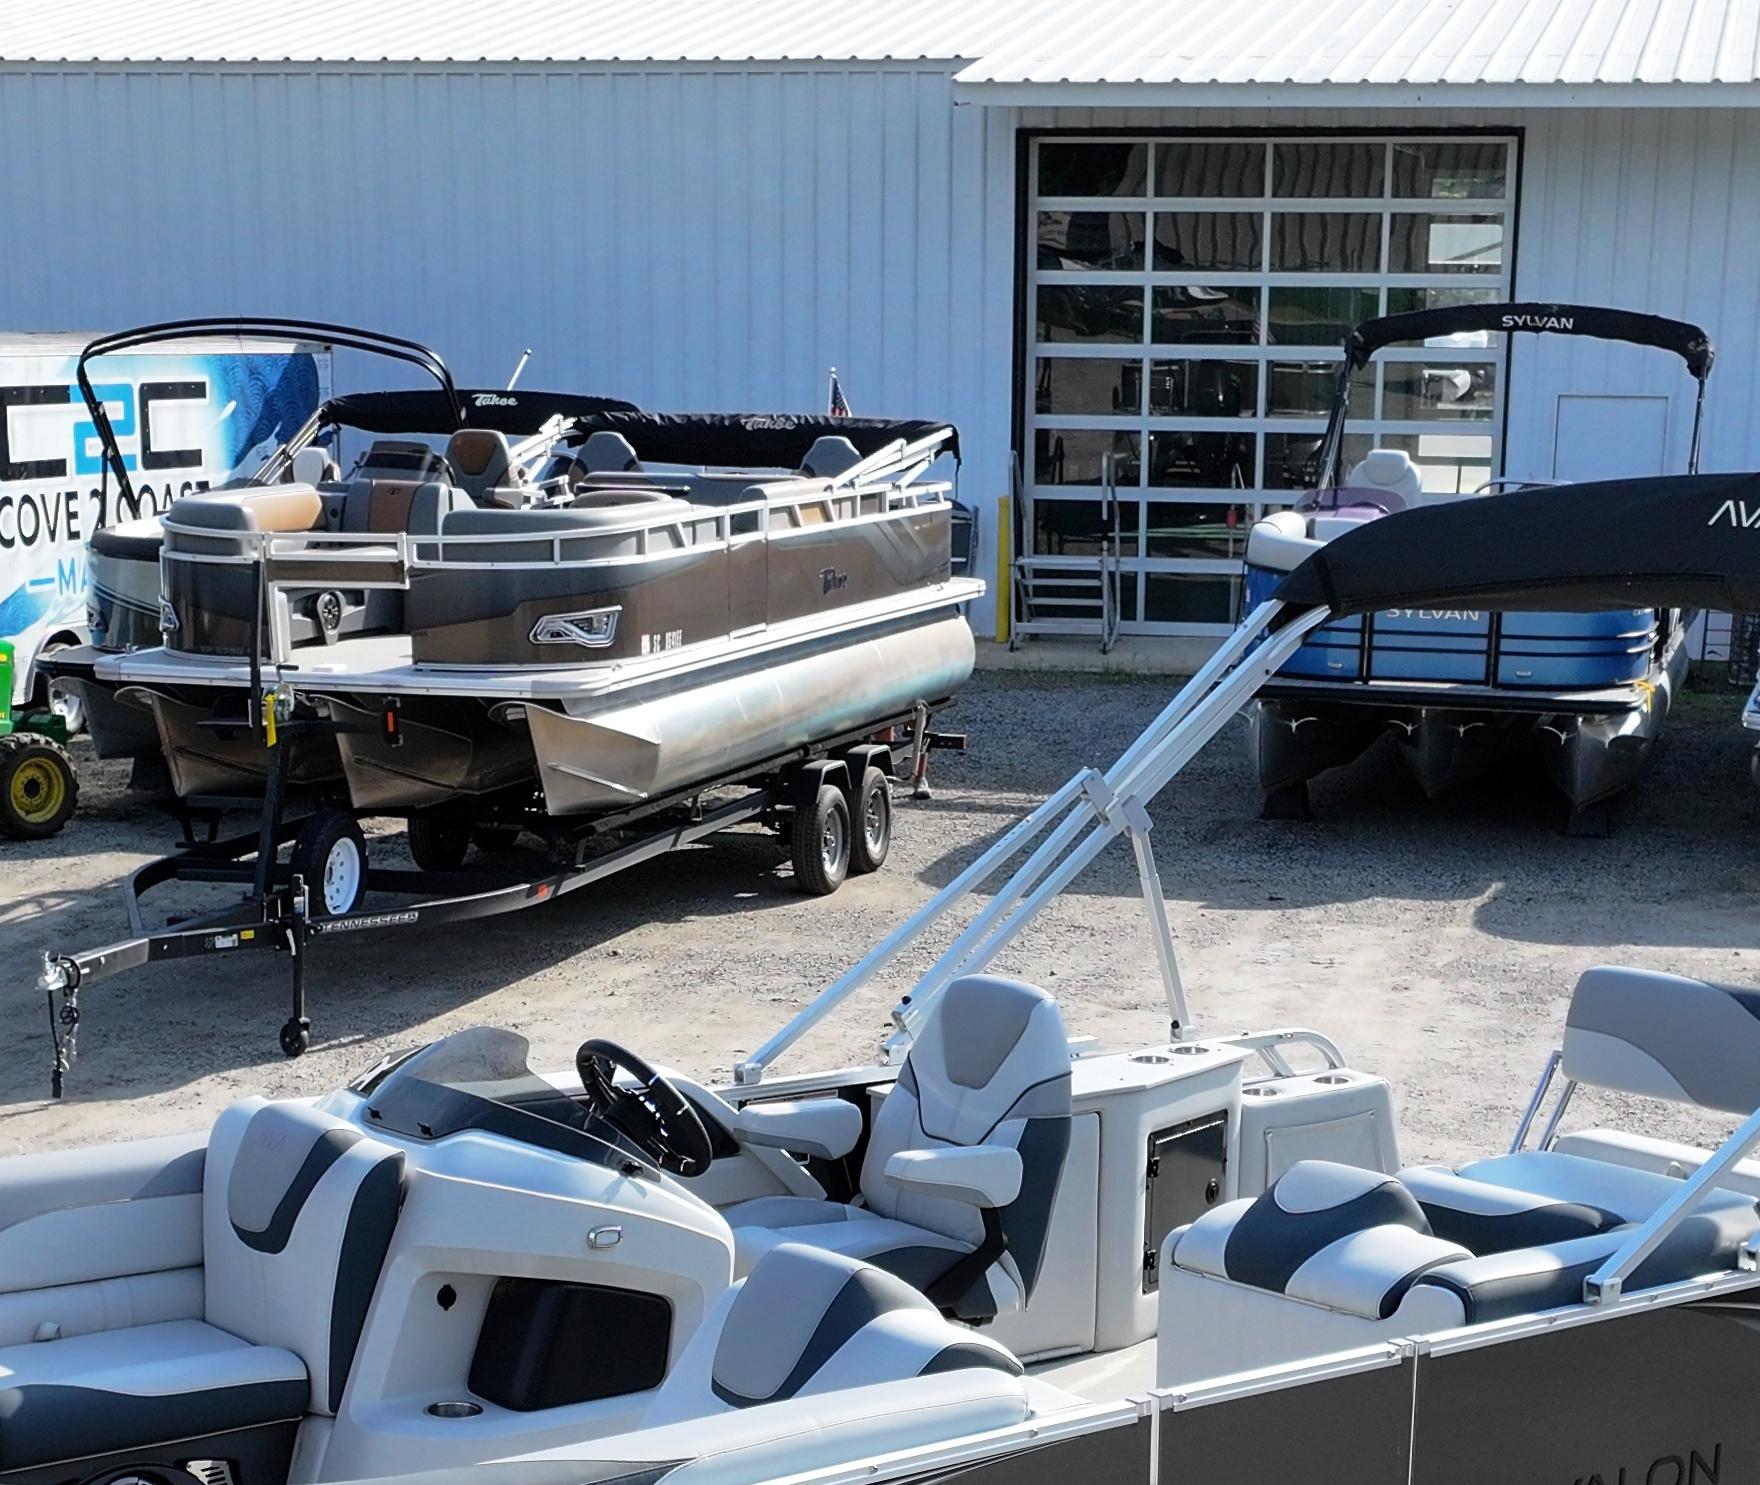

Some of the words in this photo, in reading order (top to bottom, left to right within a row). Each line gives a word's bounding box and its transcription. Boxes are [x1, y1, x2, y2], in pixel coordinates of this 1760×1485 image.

[1501, 314, 1575, 330] SYLVAN
[115, 480, 210, 523] COA
[1385, 606, 1480, 621] SYLVAN
